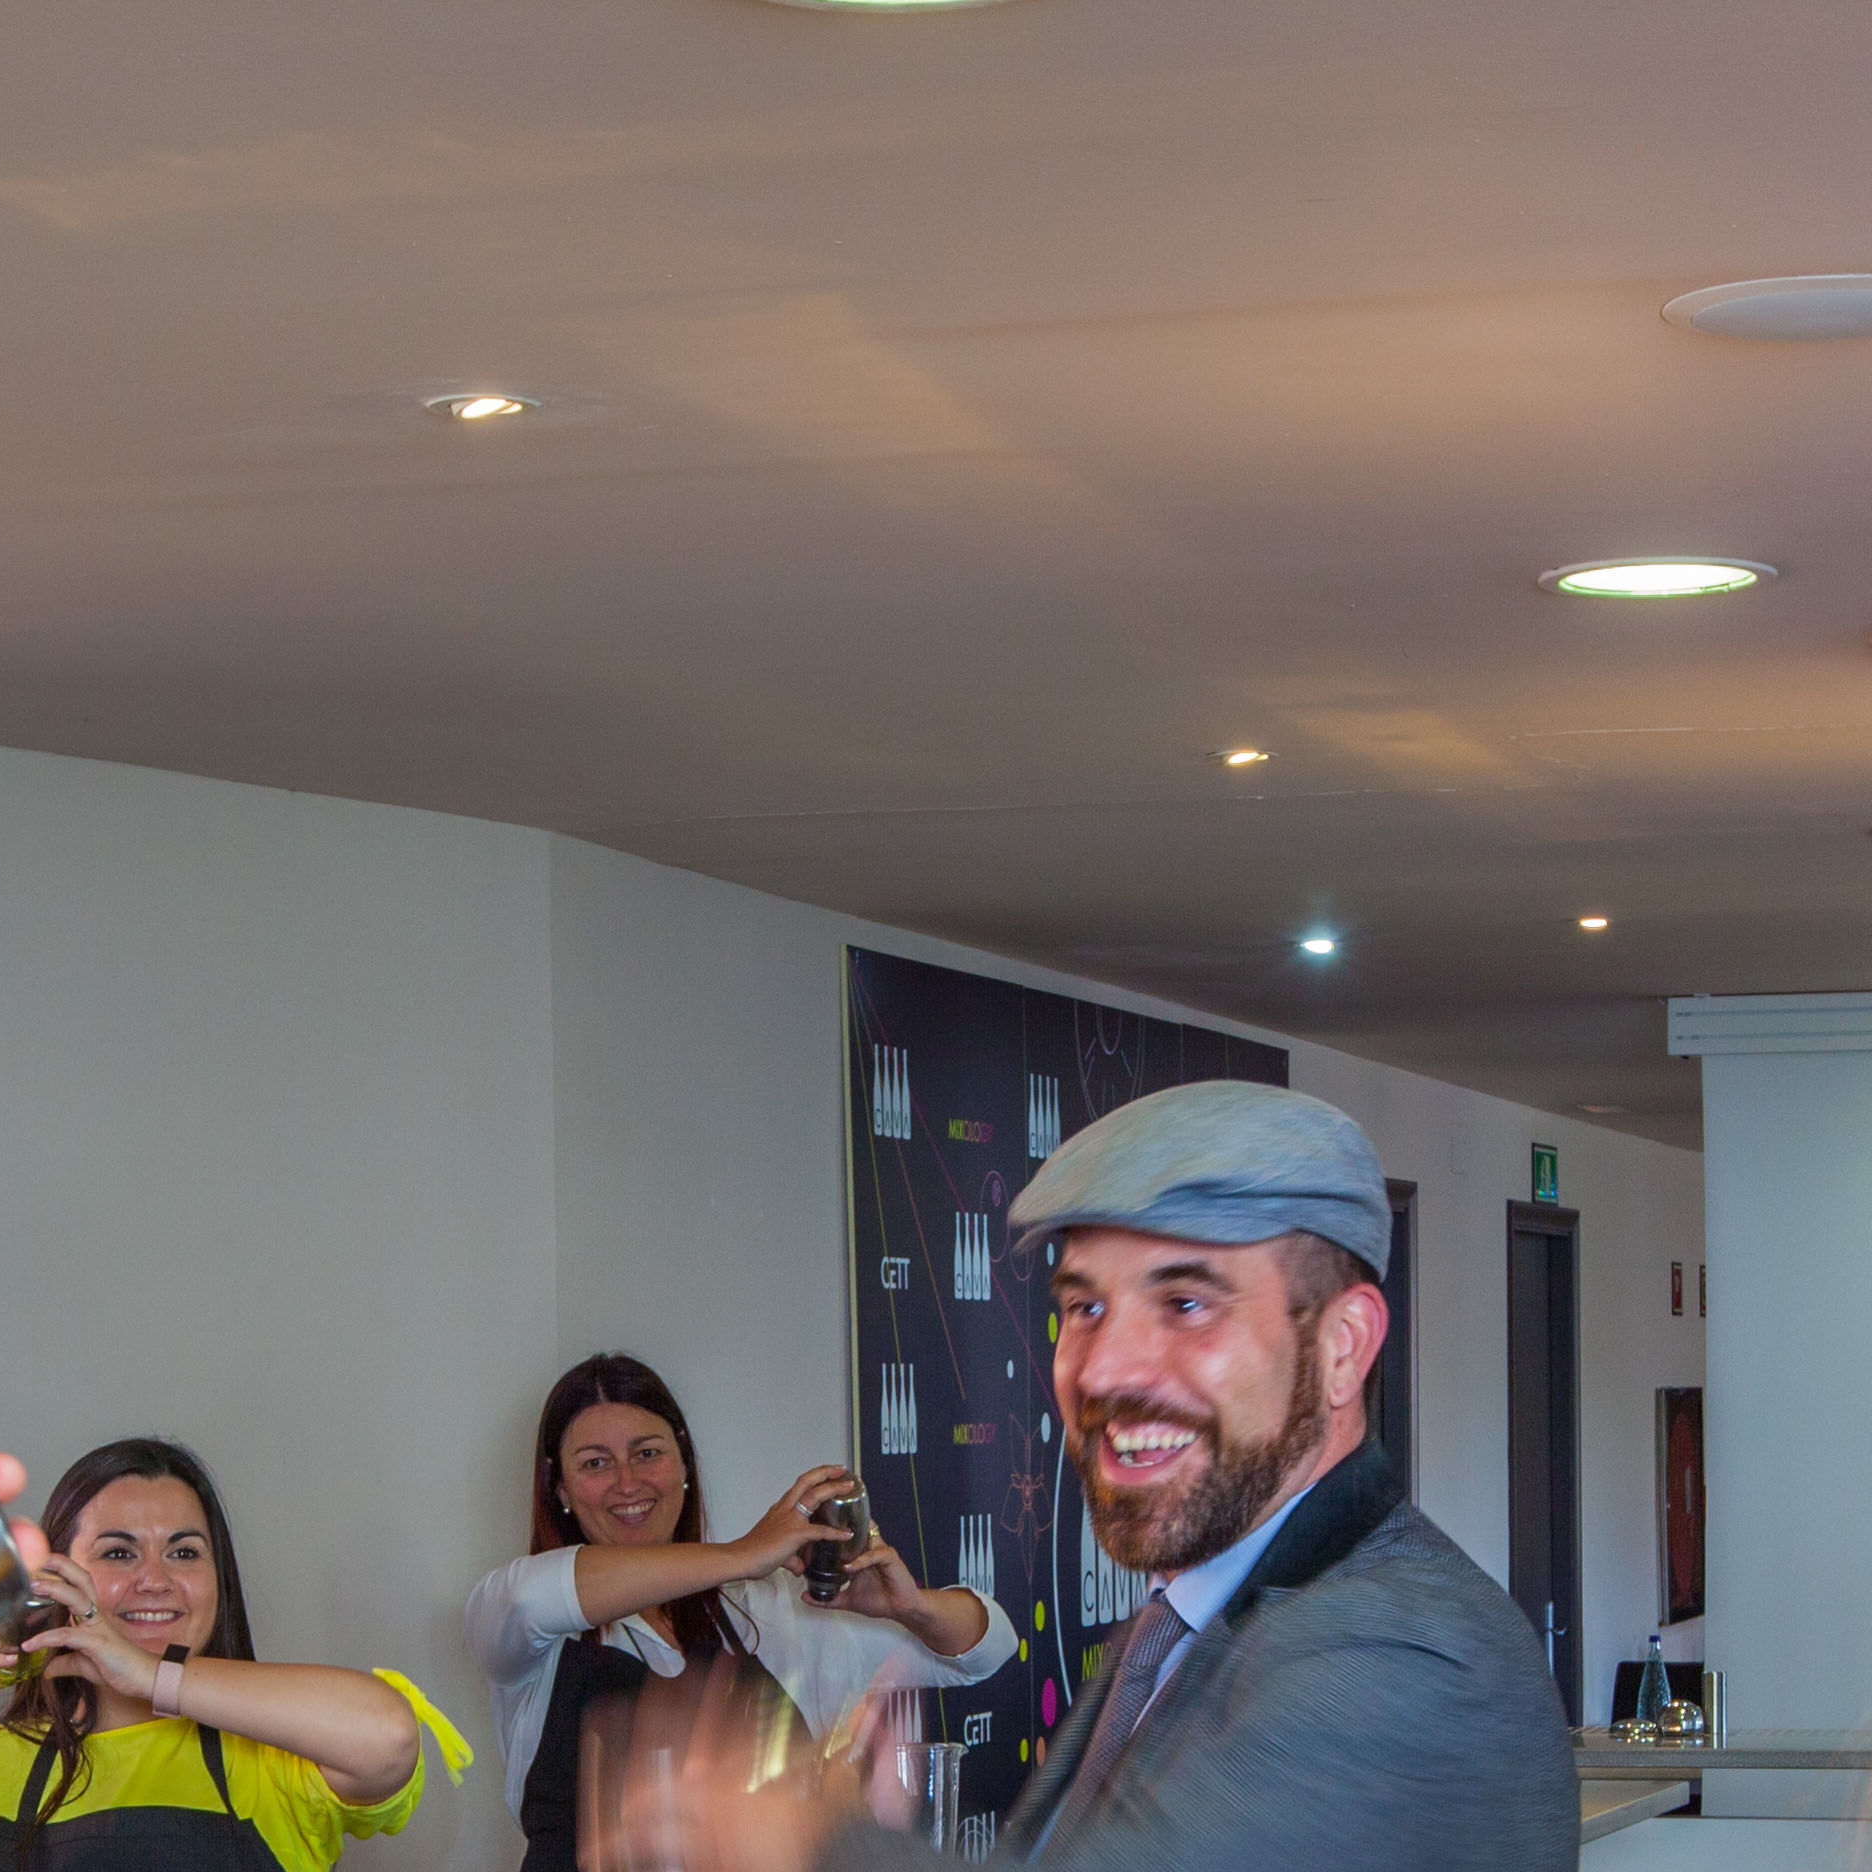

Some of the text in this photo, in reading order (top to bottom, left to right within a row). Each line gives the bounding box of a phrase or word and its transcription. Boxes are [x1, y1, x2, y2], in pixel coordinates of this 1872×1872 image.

[948, 1119, 993, 1143] MIXOLOGY
[880, 1256, 910, 1290] CETT
[953, 1423, 996, 1445] MIXOLOGY
[1083, 1566, 1145, 1612] CAVA
[963, 1711, 993, 1747] CETT
